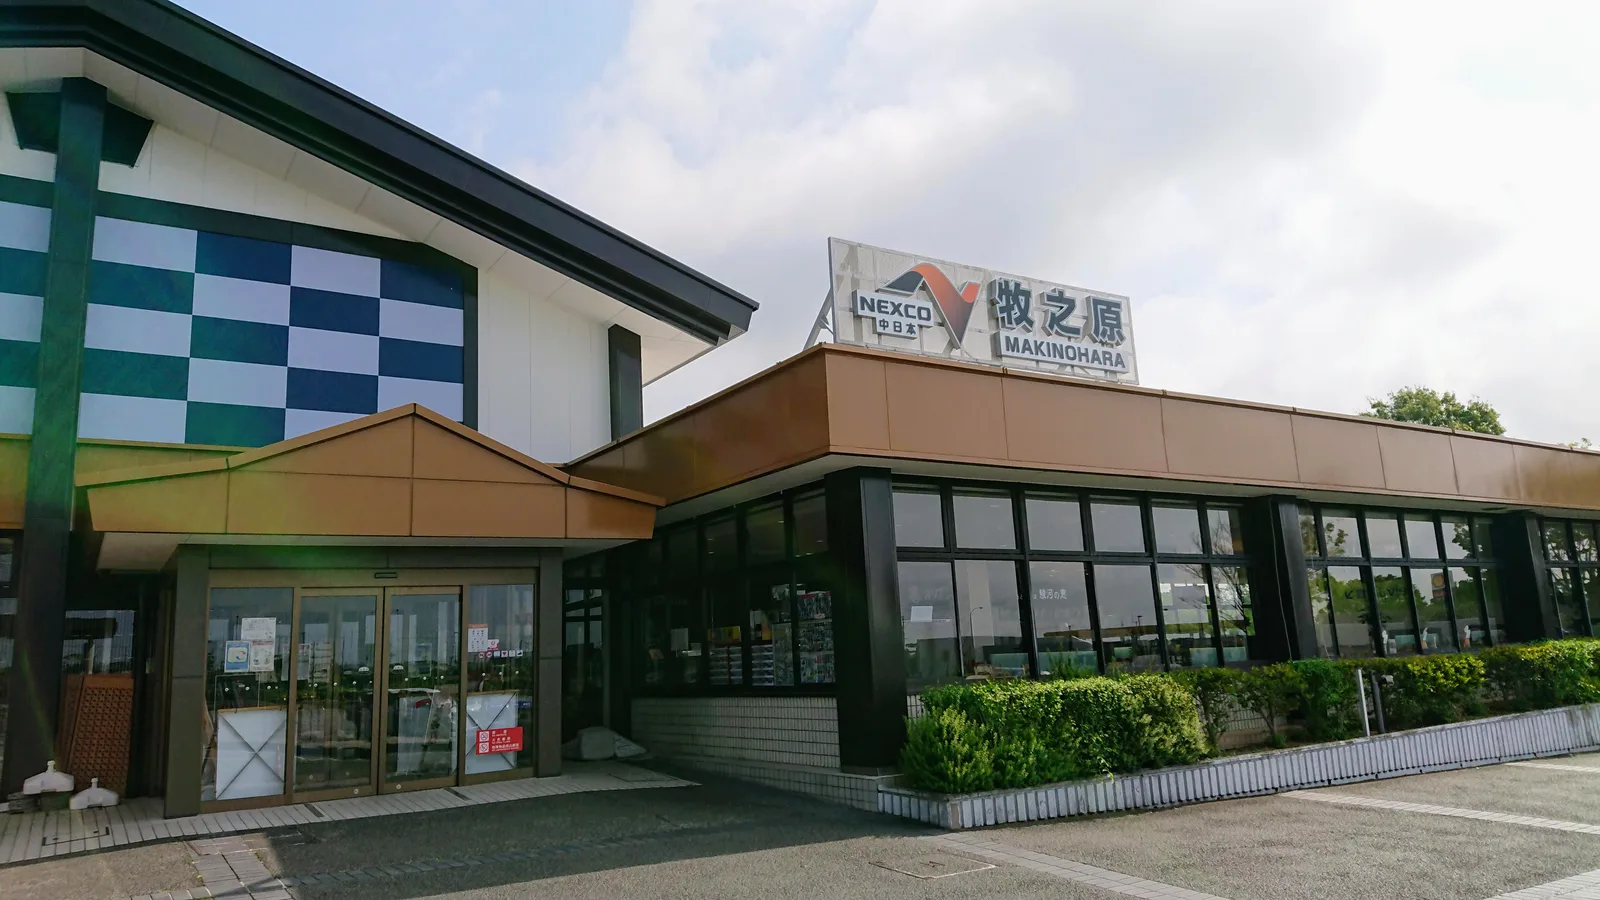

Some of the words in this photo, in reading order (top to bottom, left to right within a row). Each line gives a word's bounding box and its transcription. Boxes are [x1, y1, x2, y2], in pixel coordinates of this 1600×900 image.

[859, 295, 932, 322] NEXCO
[996, 276, 1127, 344] 牧之原
[878, 318, 917, 336] 中日本
[1004, 335, 1126, 369] MAKINOHARA
